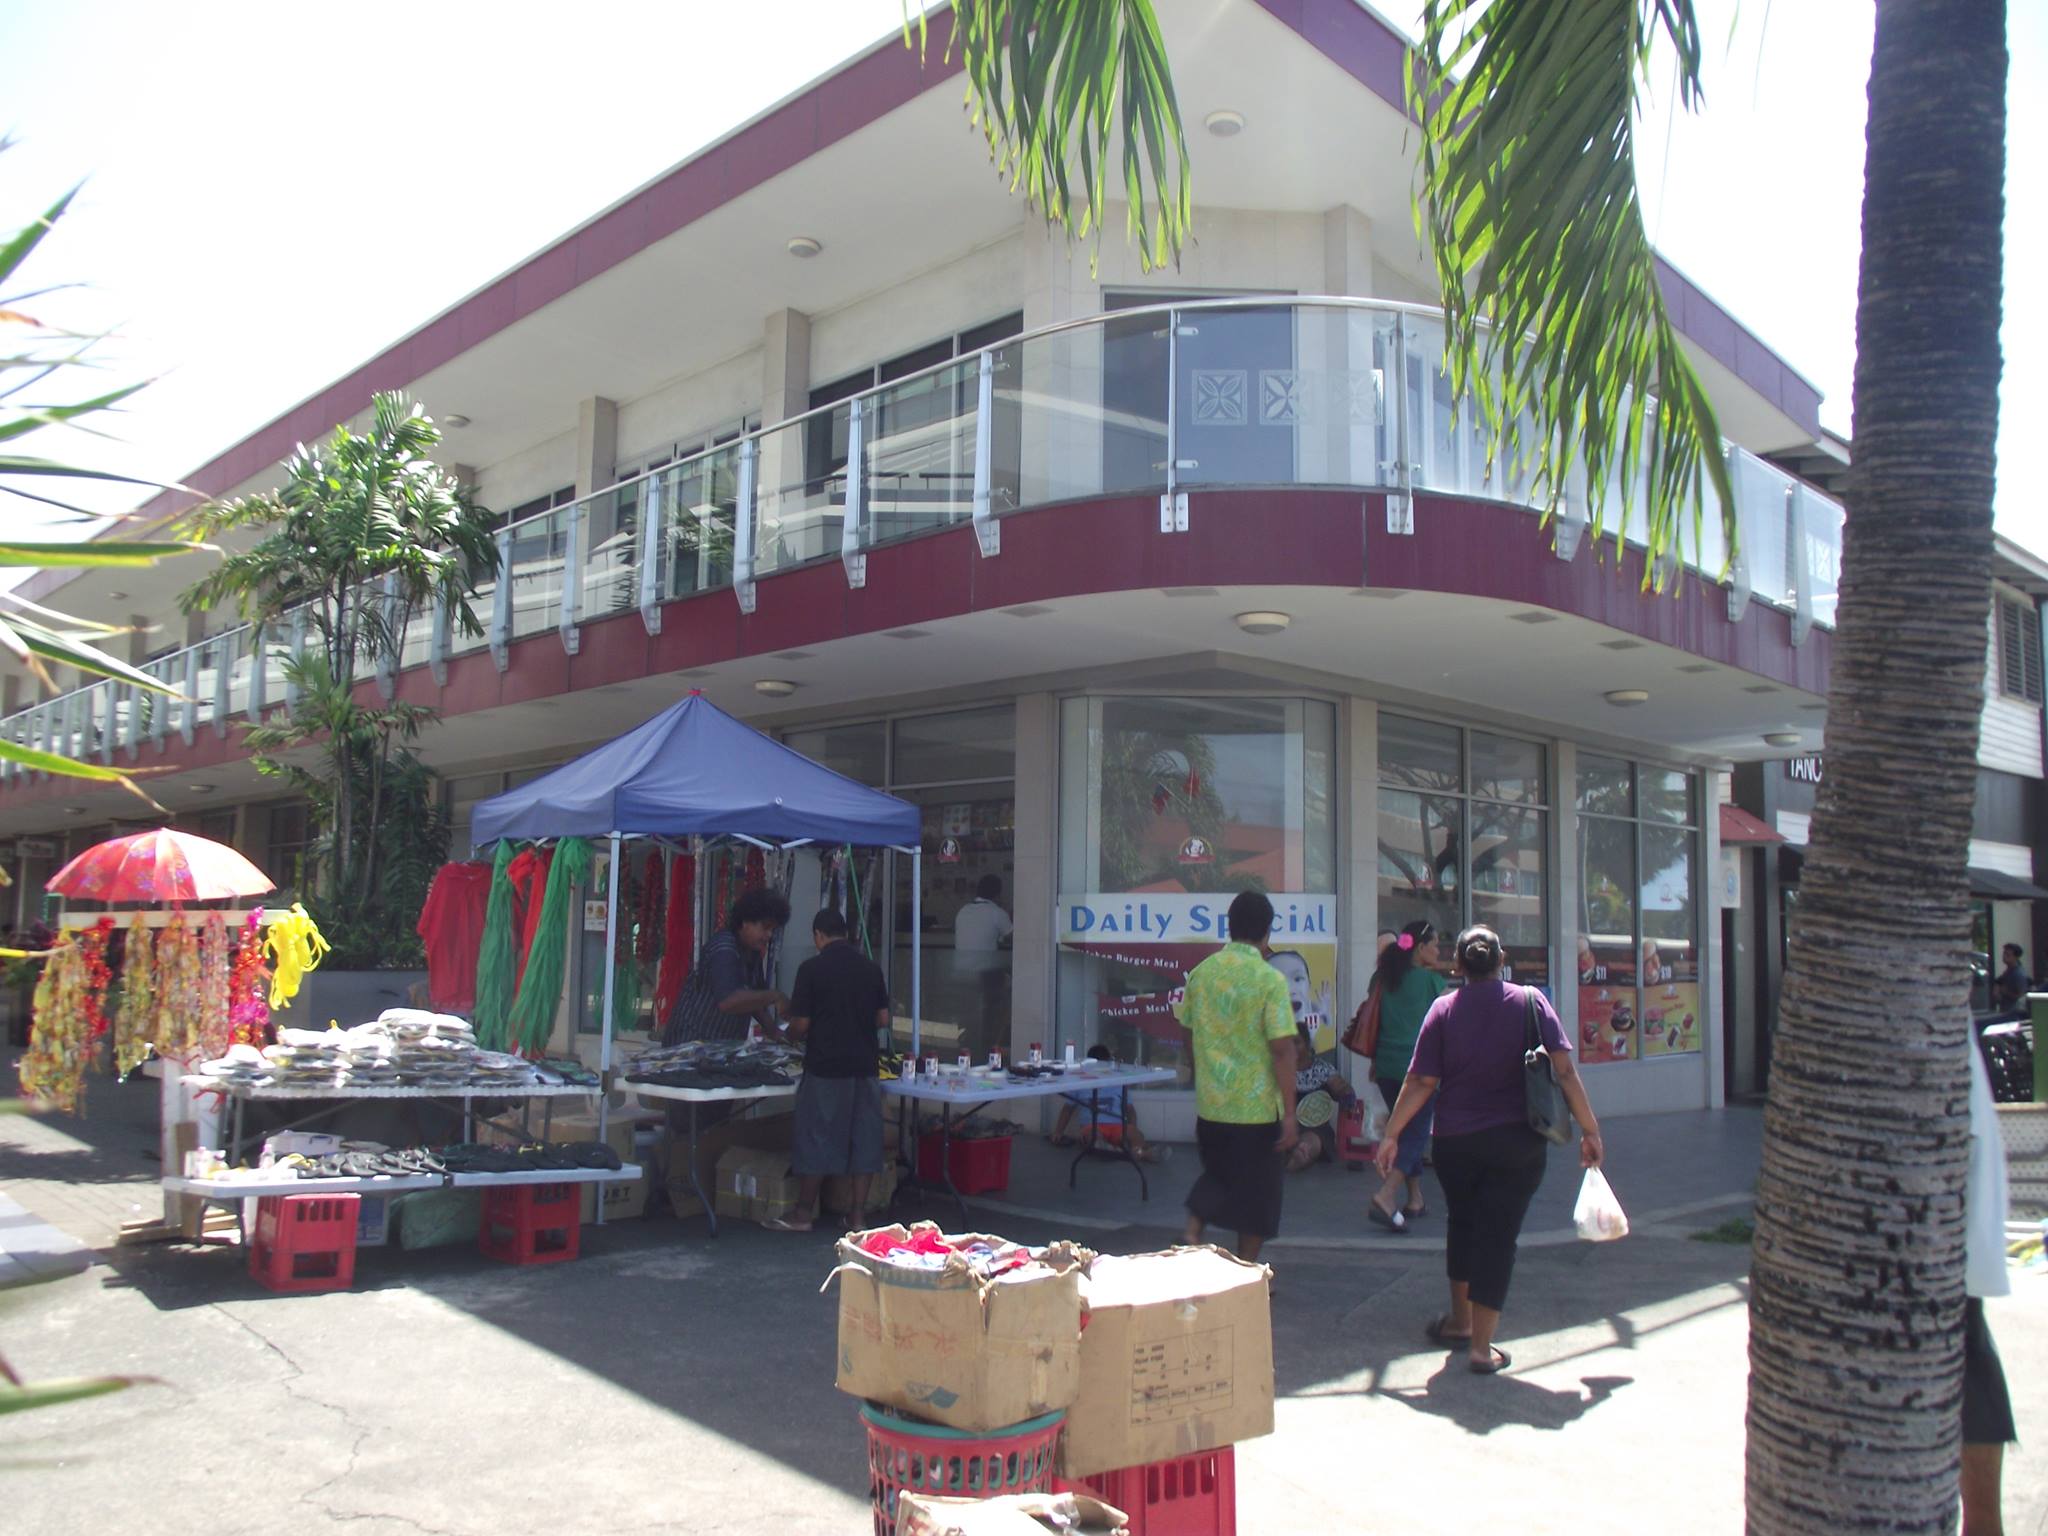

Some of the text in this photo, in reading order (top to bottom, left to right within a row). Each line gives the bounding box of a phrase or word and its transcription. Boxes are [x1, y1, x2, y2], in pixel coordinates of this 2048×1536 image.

[1189, 903, 1327, 939] Spcial
[1116, 953, 1151, 967] Burger
[1153, 958, 1179, 969] Meal
[1145, 1003, 1170, 1014] Meal
